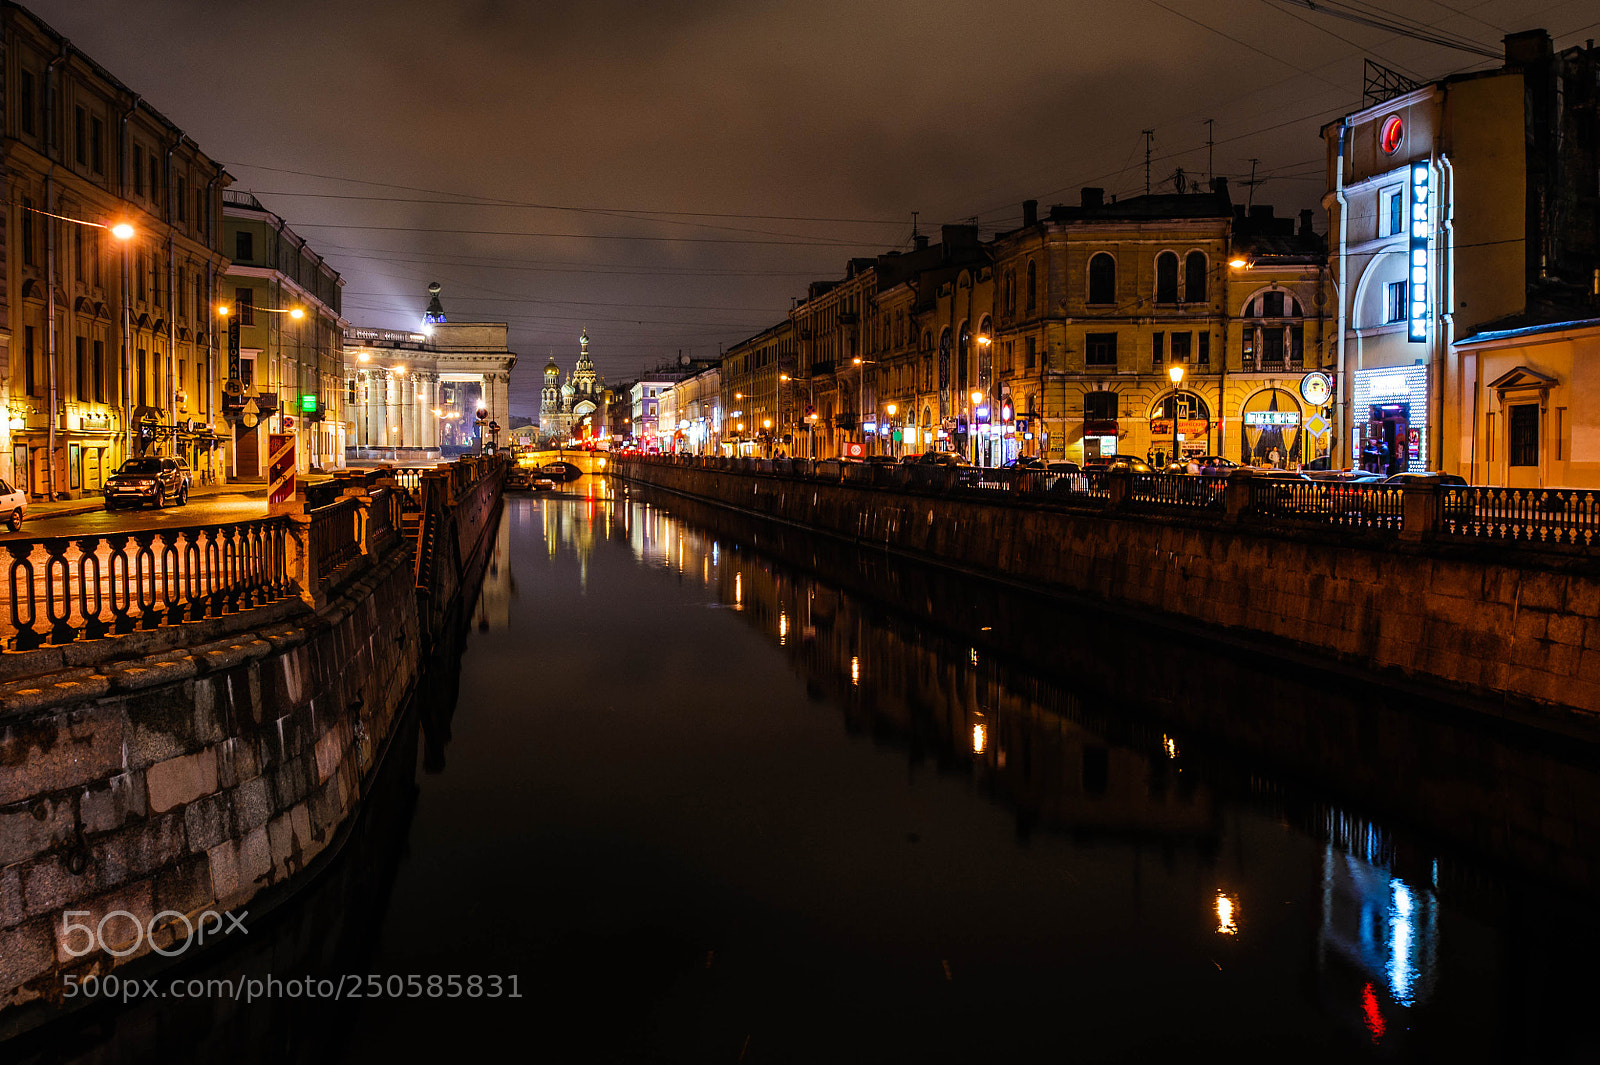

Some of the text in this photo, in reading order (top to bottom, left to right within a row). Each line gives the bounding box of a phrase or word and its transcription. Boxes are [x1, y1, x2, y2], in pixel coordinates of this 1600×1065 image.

[1411, 167, 1428, 337] РУКИ ВВЕРХ
[229, 318, 238, 379] РЕСТОРАН
